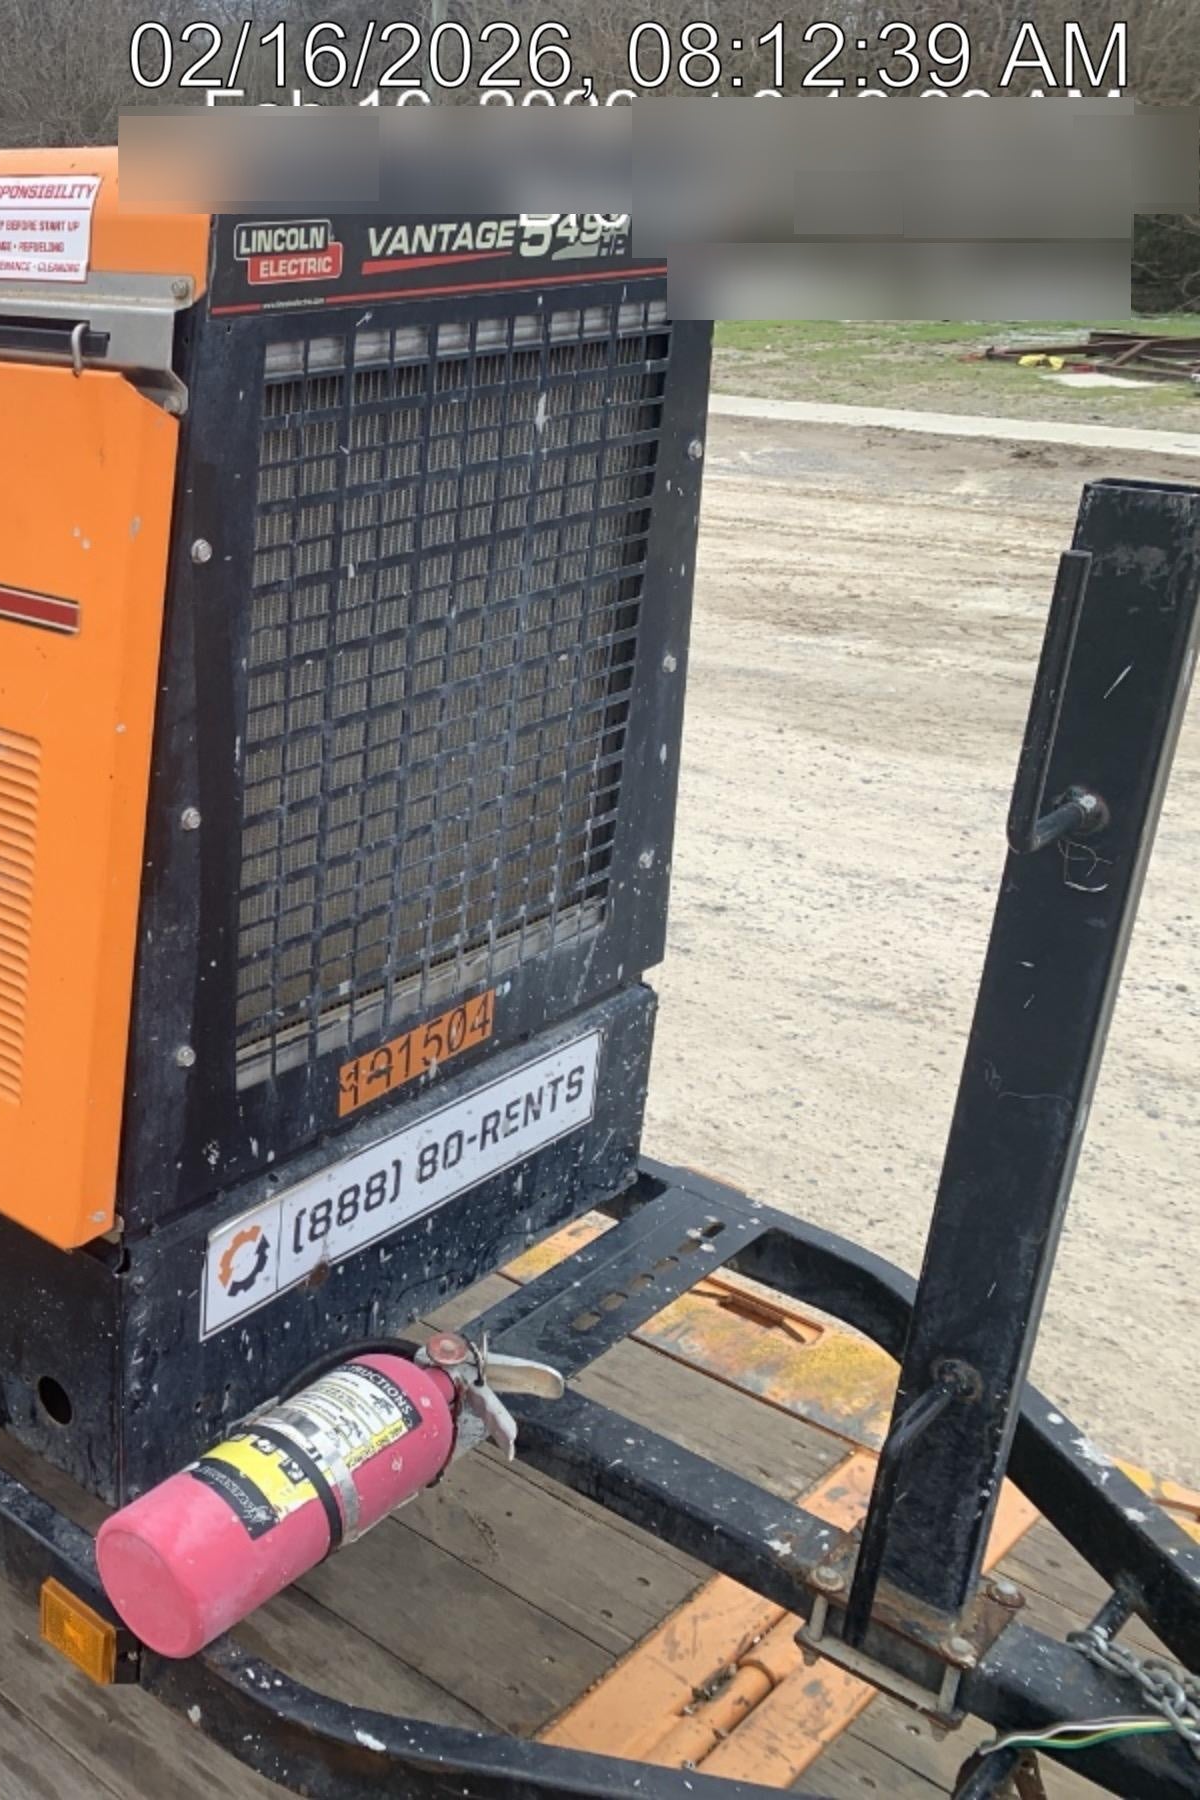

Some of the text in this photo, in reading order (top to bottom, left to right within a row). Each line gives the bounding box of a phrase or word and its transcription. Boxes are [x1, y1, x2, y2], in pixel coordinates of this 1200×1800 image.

[239, 224, 325, 256] LINCOLN
[367, 220, 517, 258] VANTAGE
[259, 255, 334, 279] ELECTRIC
[339, 1005, 492, 1107] 191504
[291, 1063, 585, 1255] (888) 80-RENTS
